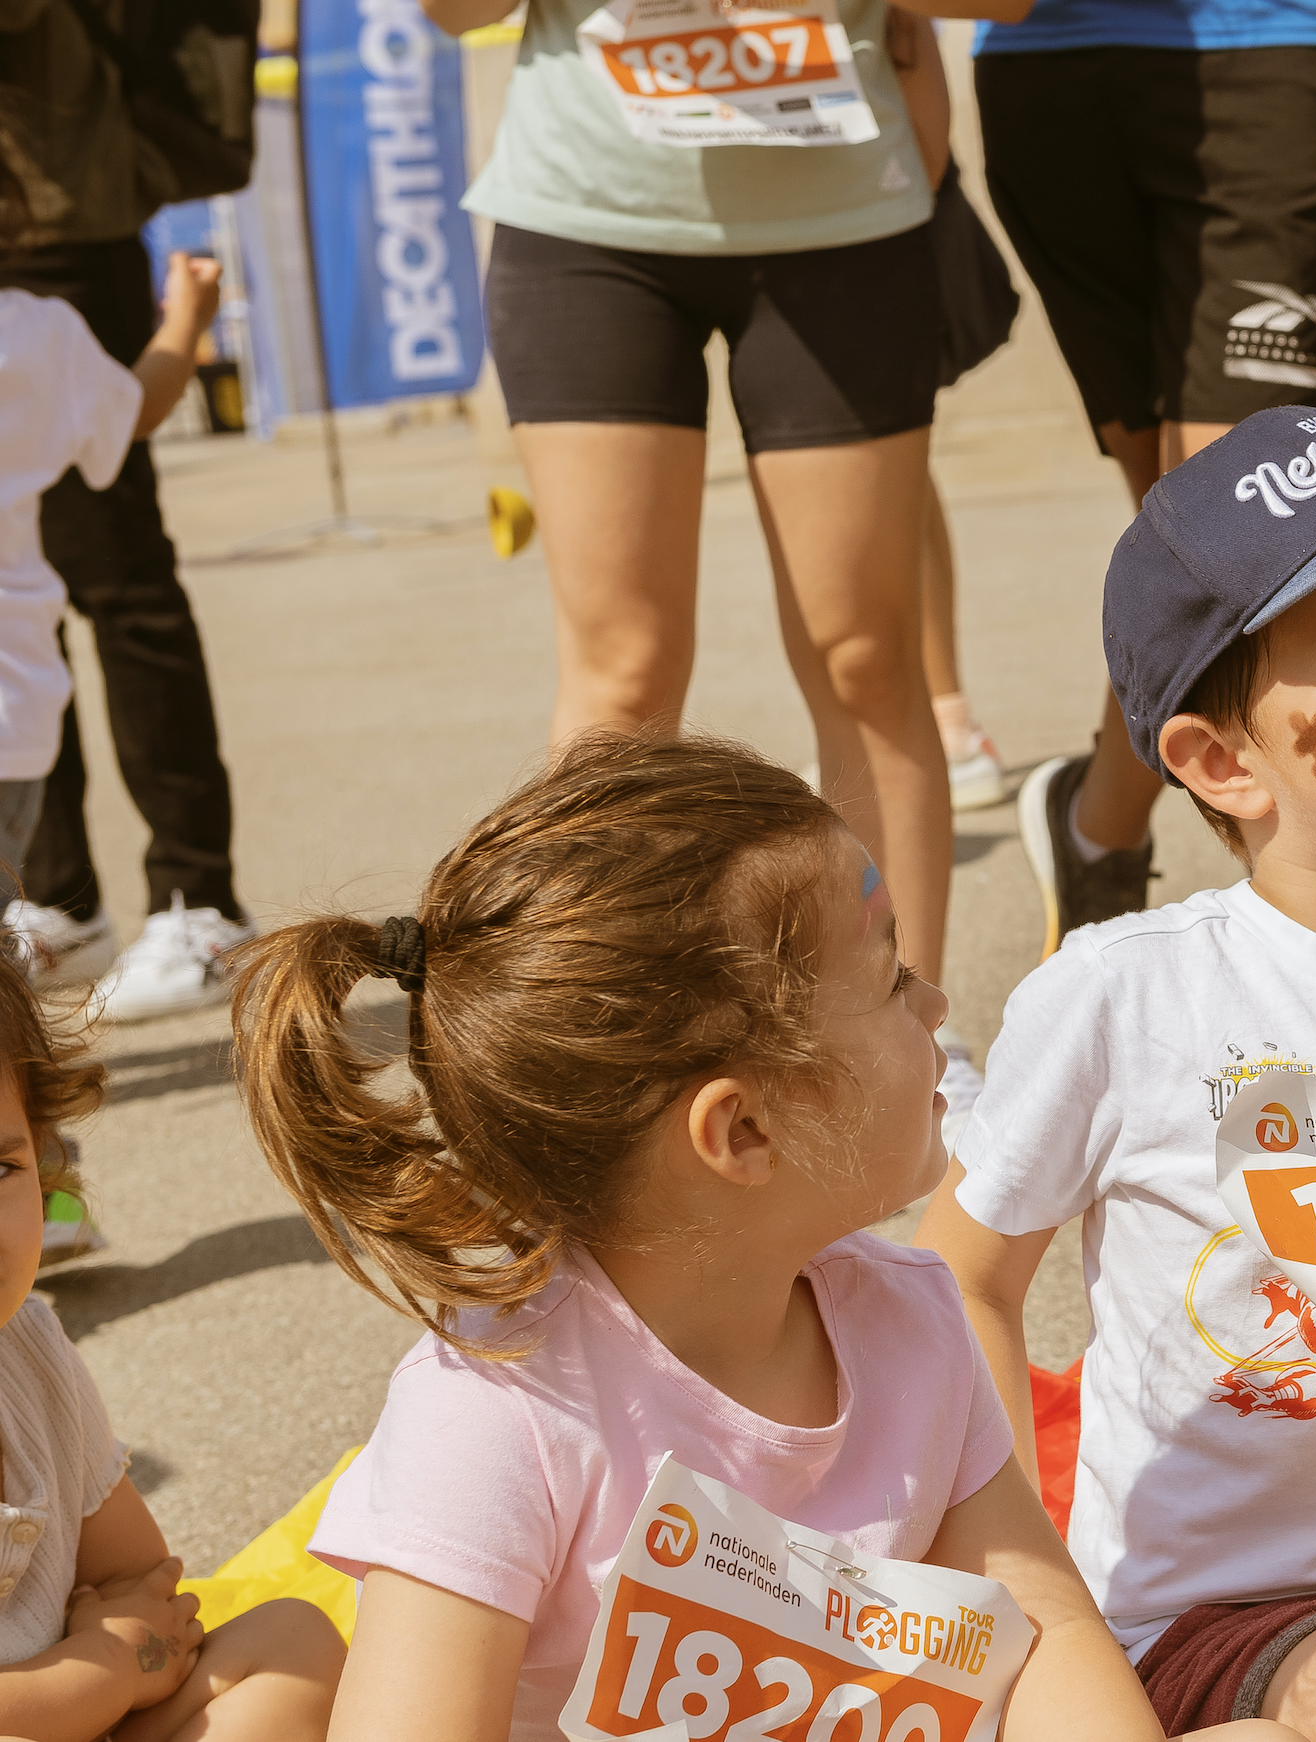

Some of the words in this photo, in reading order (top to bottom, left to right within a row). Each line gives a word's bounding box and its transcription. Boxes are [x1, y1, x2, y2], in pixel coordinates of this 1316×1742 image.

[619, 26, 810, 95] 18207
[1220, 1066, 1243, 1077] THE
[1248, 1063, 1313, 1075] INVINCIBLE
[709, 1531, 778, 1576] nationale
[703, 1551, 802, 1608] nederlanden
[957, 1604, 996, 1633] TOUR
